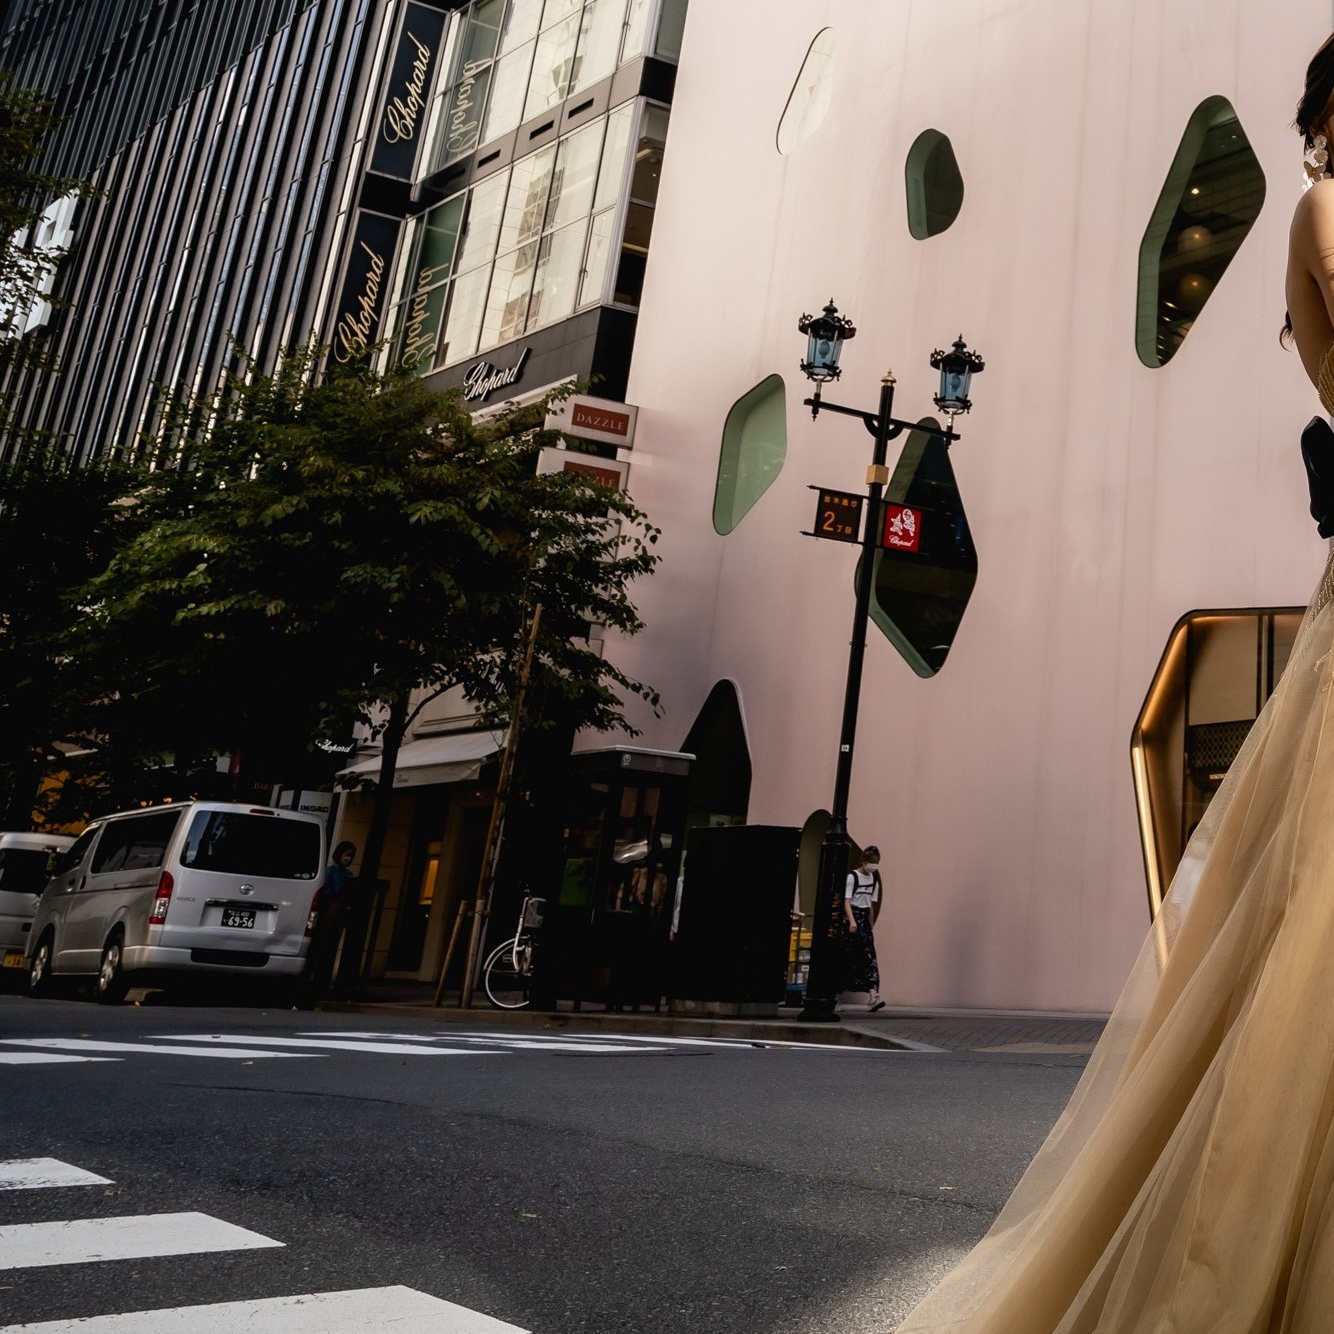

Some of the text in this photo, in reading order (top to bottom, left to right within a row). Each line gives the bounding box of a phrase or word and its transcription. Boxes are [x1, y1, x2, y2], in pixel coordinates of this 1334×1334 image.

[382, 30, 431, 146] Chopard
[333, 239, 385, 364] Chopard
[463, 347, 530, 401] Chopard
[576, 412, 624, 431] DAZZLE
[228, 916, 254, 928] 69-56
